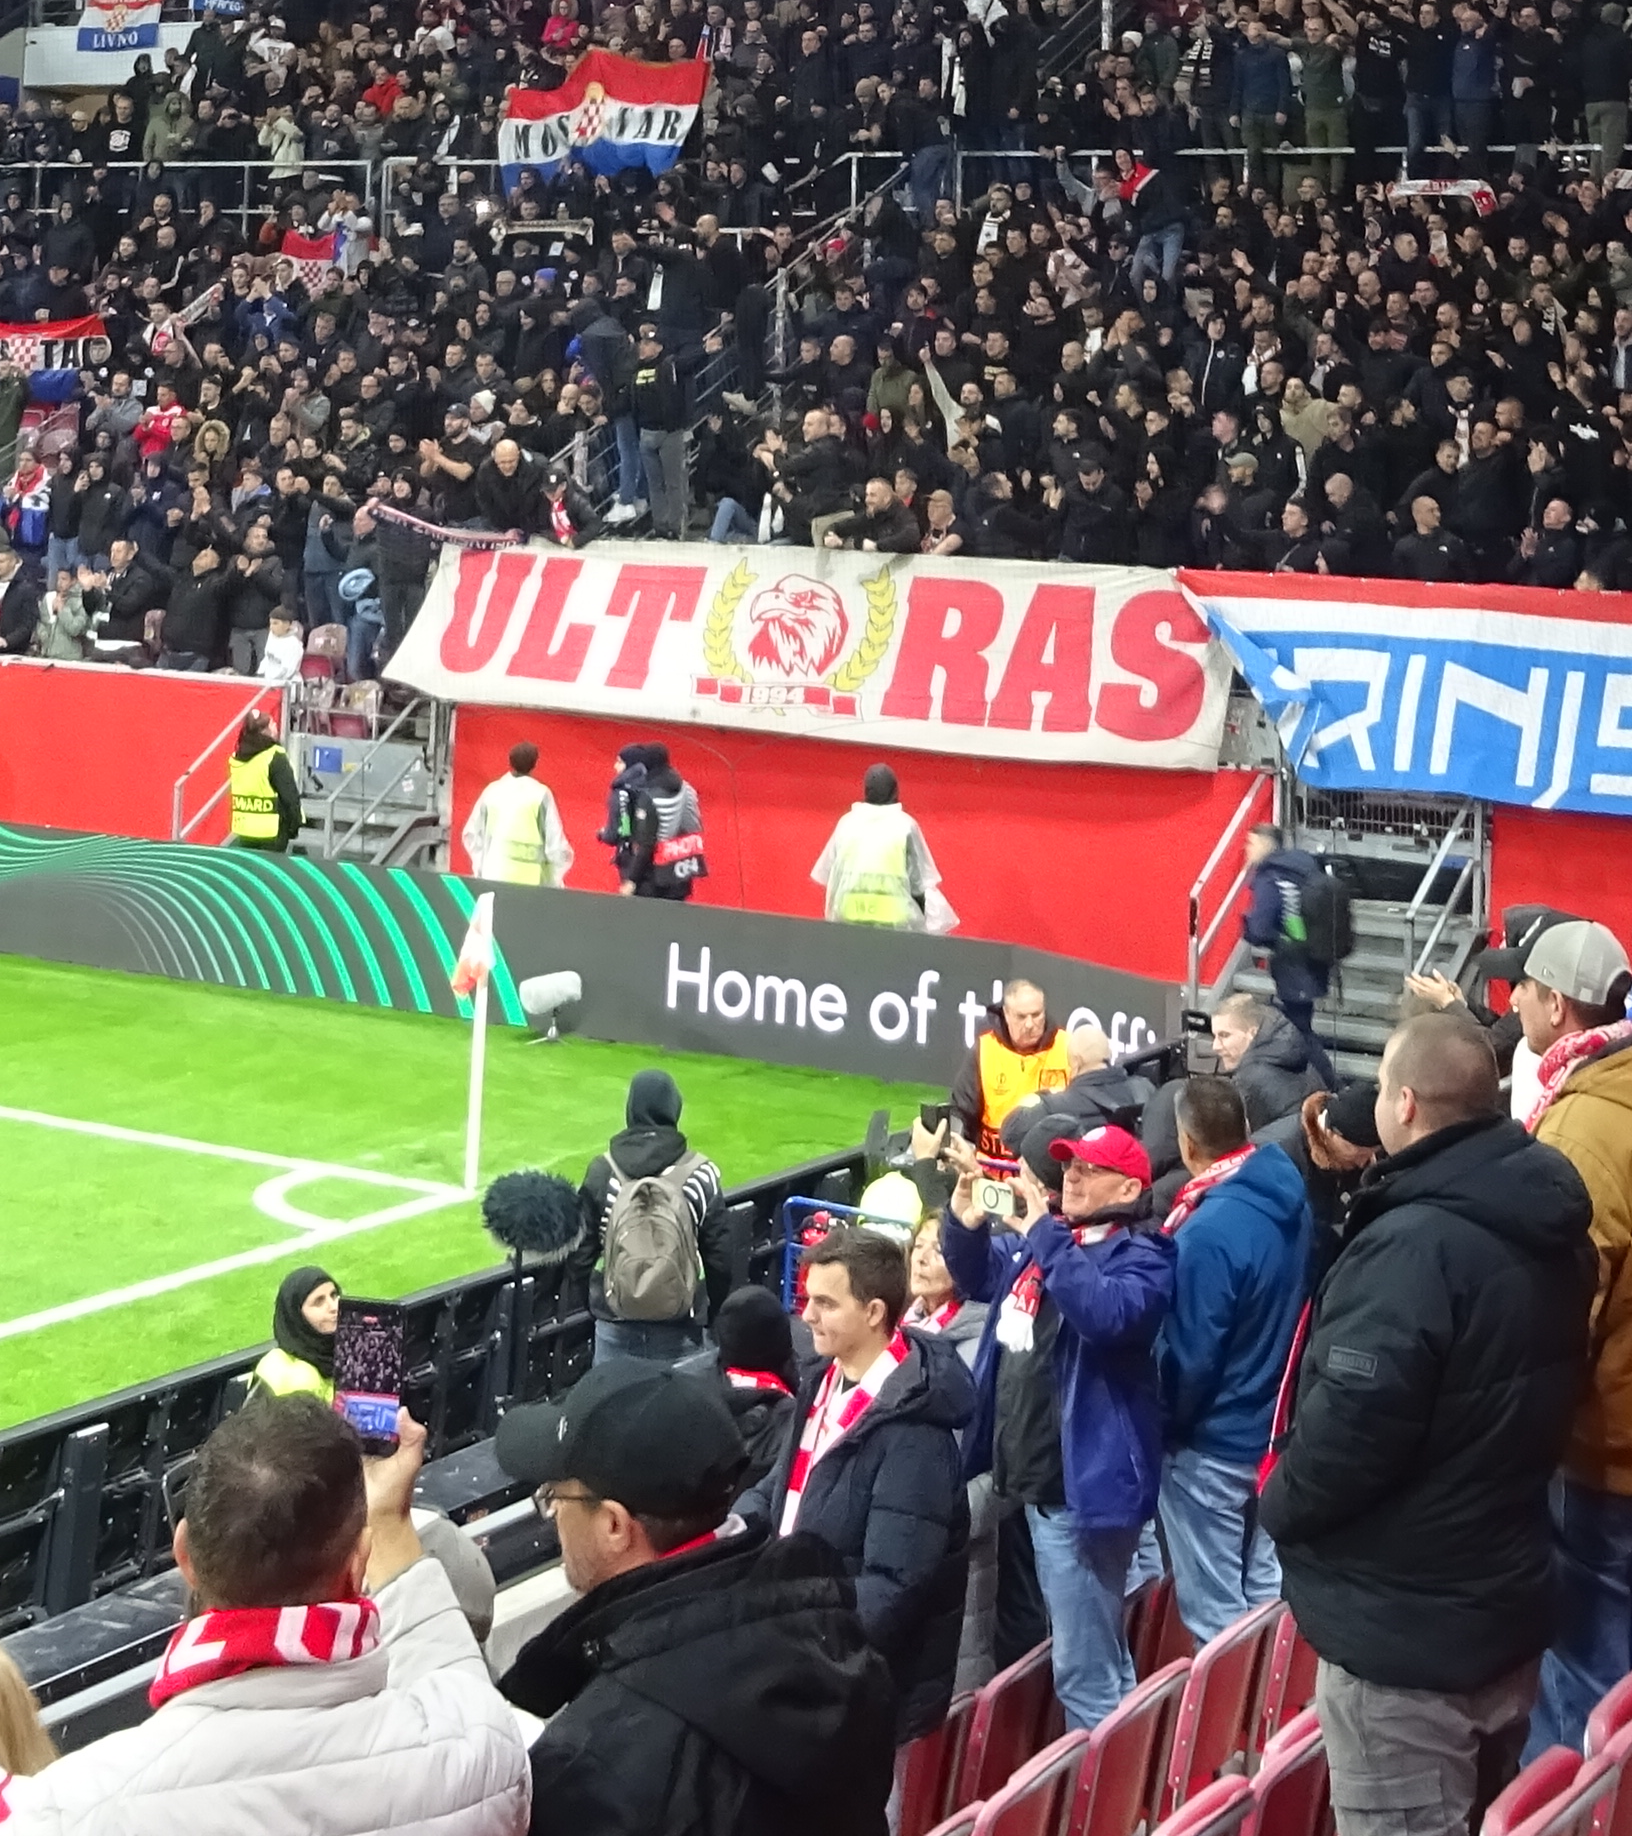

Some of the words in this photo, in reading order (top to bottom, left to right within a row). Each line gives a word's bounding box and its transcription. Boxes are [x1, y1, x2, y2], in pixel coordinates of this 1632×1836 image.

[93, 32, 139, 49] LIVNO
[741, 685, 804, 705] 1994
[667, 942, 848, 1033] Home
[869, 969, 940, 1045] of
